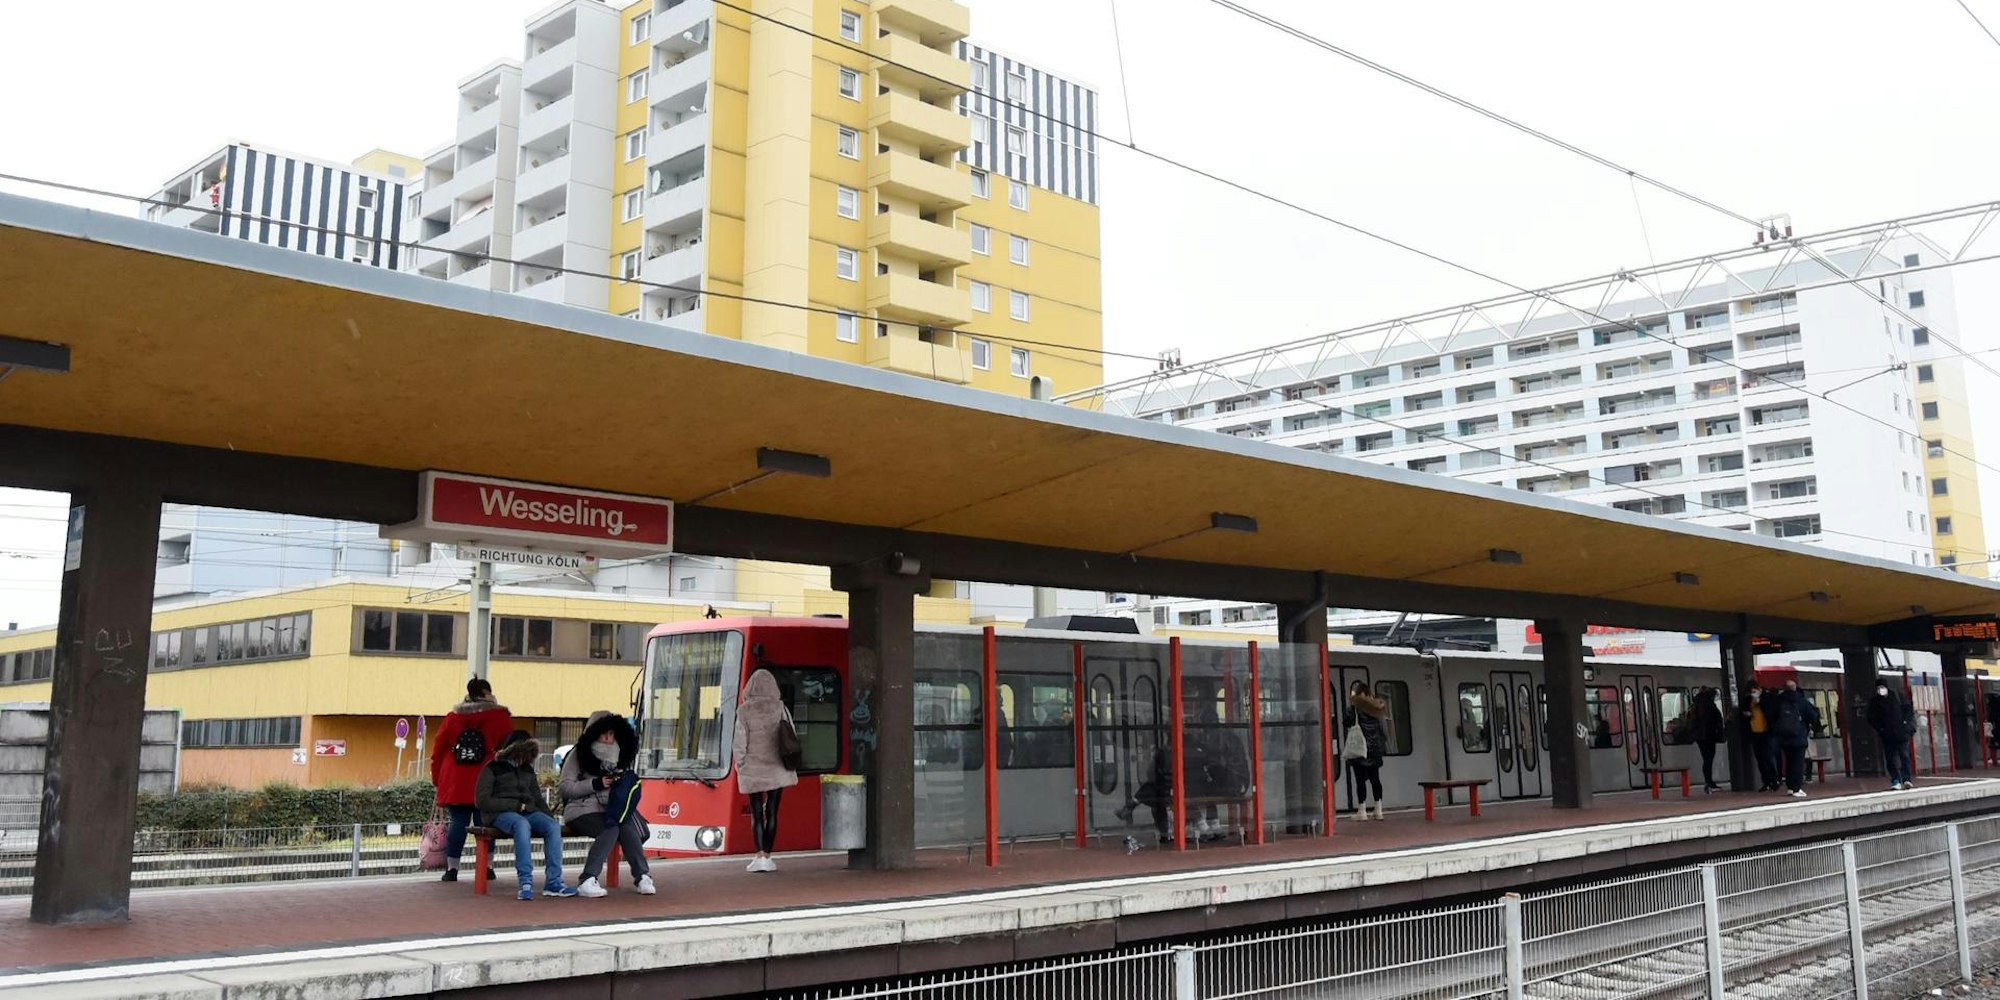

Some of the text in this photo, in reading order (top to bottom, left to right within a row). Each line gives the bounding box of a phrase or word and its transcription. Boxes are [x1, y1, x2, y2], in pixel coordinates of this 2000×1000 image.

[479, 487, 624, 536] Wesseling
[480, 549, 580, 568] RICHTUNG KÖLN
